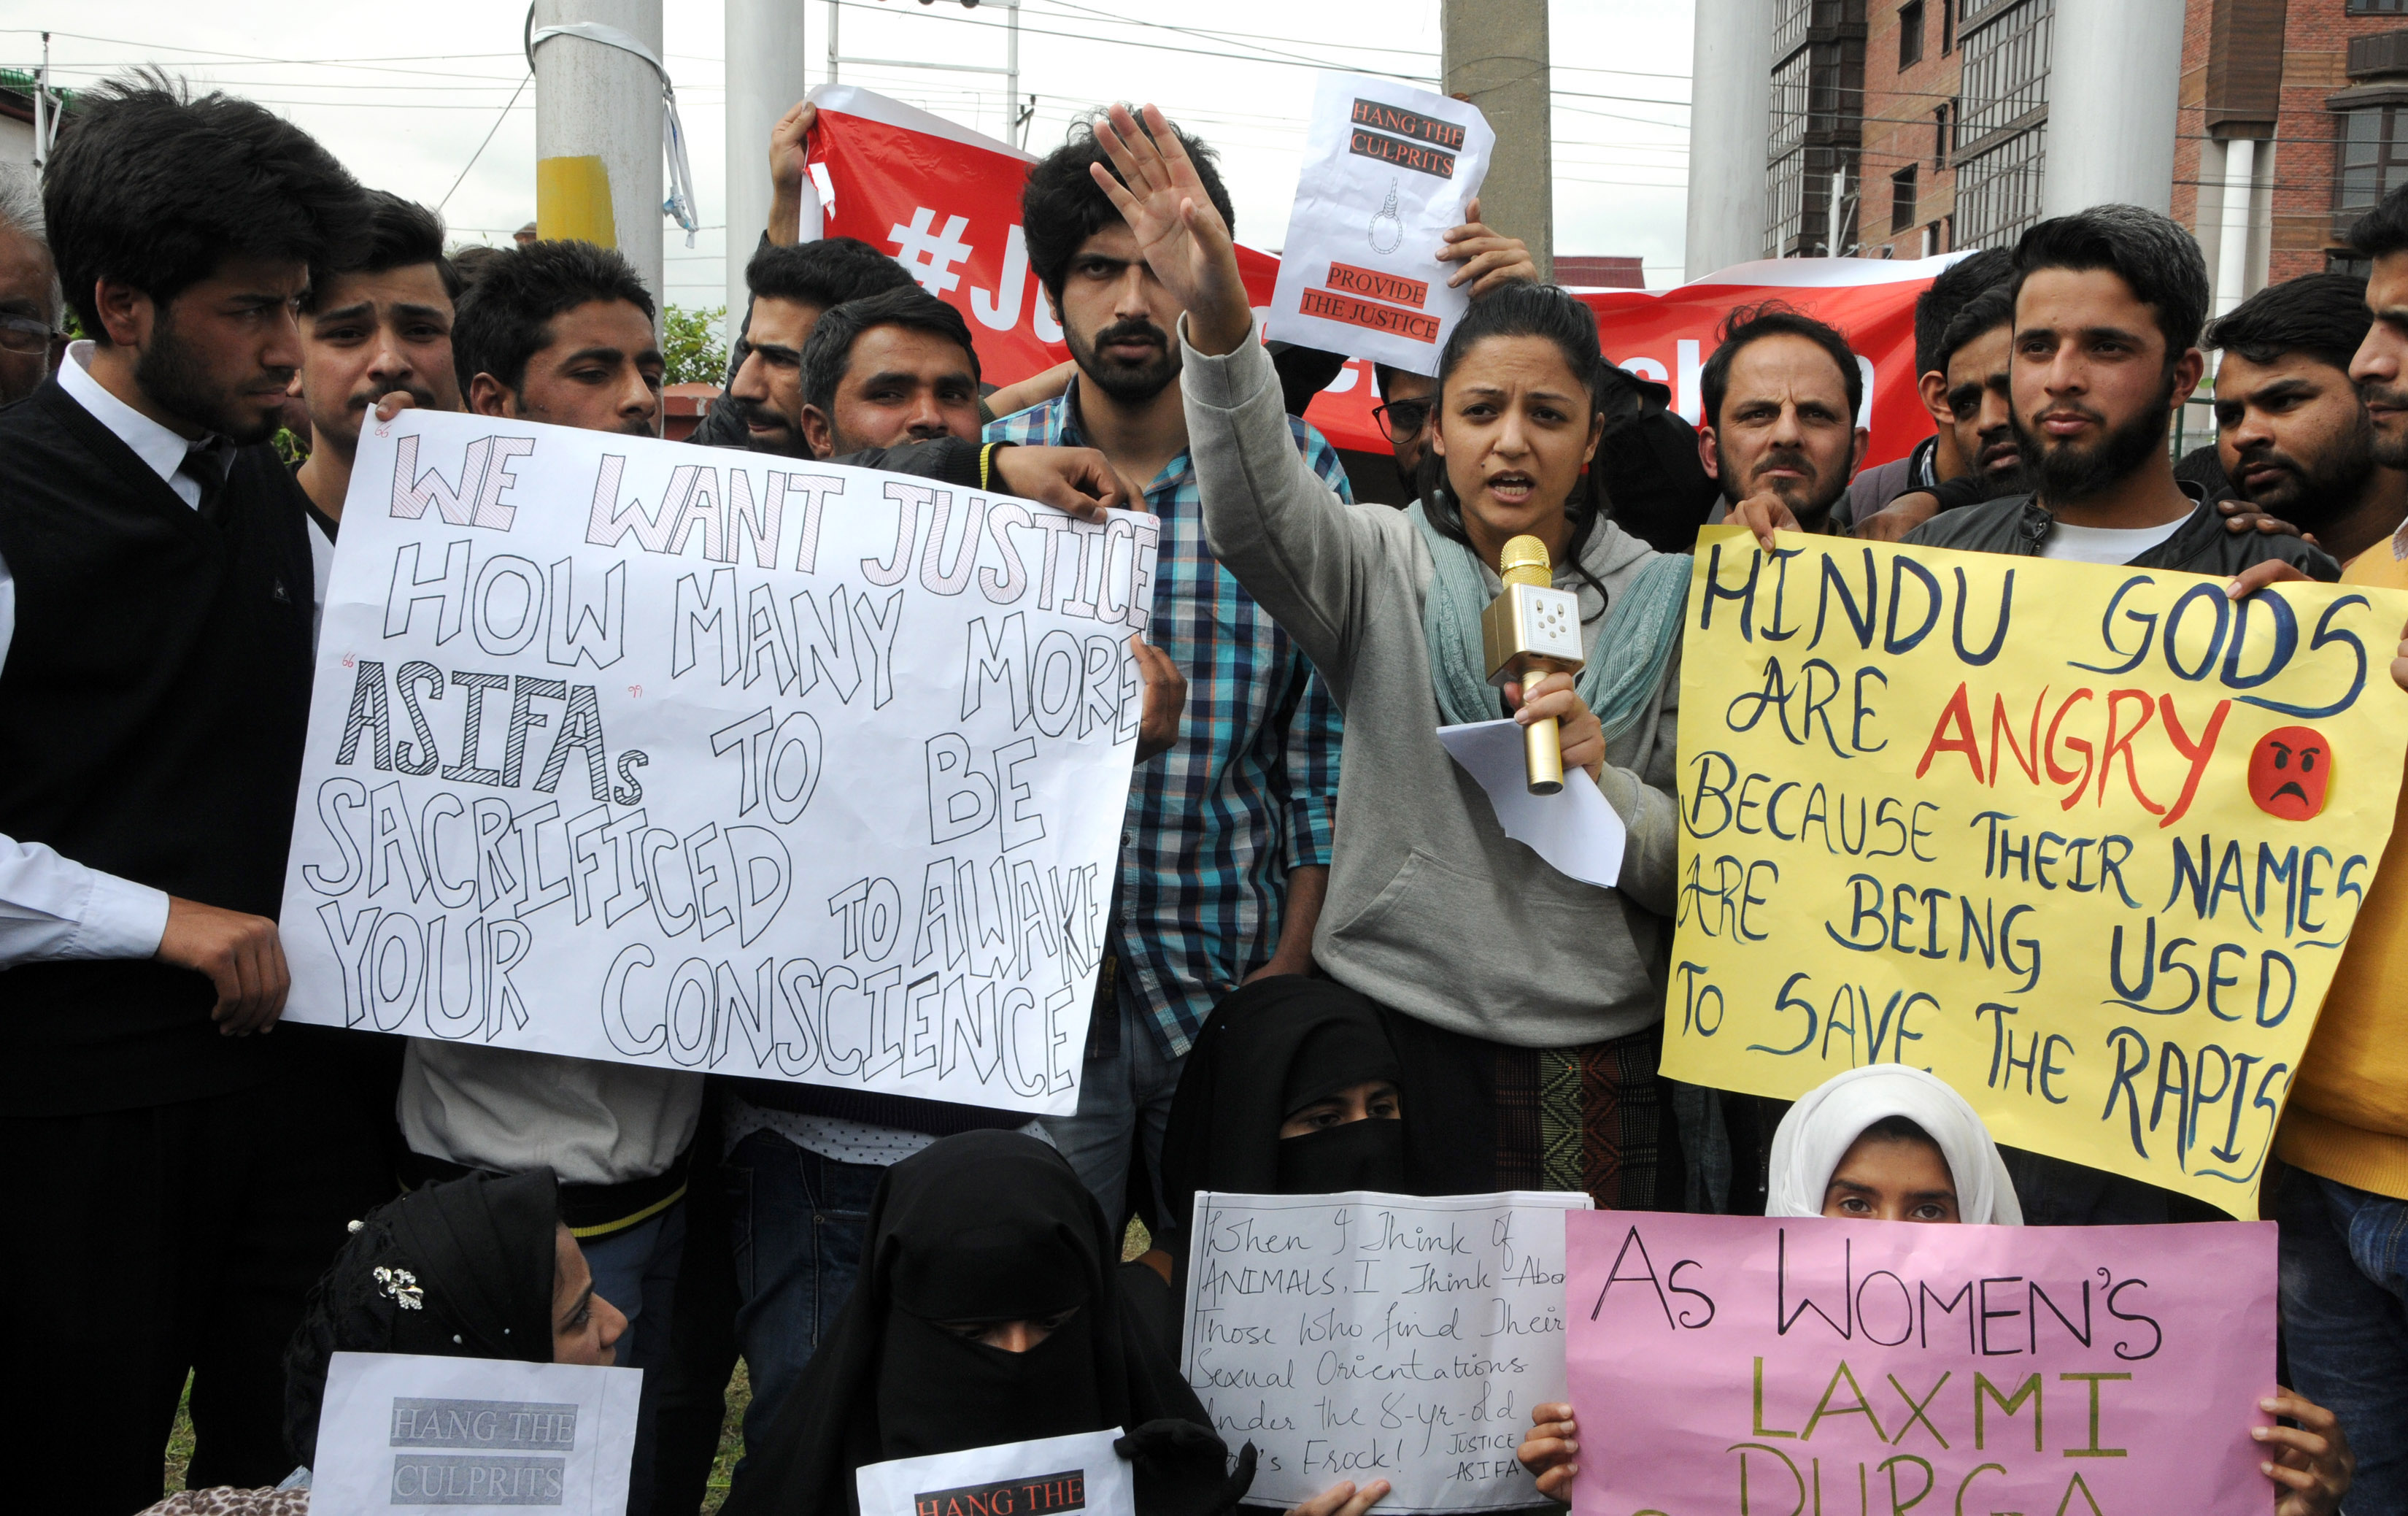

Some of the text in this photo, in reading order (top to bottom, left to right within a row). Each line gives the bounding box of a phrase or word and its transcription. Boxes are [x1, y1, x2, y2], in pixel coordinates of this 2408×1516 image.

[1351, 132, 1454, 177] CULPRITS
[1352, 101, 1465, 147] HANG THE
[1303, 291, 1440, 340] THE JUSTICE
[1328, 266, 1427, 305] PROVIDE
[584, 453, 846, 575] WANT
[383, 539, 1143, 746] HOW MANY MORE
[1699, 543, 2372, 720] HINDU GODS
[710, 706, 822, 825] TO
[925, 732, 1046, 853] BE
[1725, 655, 2233, 830] ARE ANGRY
[303, 777, 1102, 985] SACRIFICED TO AWAKE
[1680, 750, 2368, 950] BECAUSE THEIR NAMES
[1678, 853, 2297, 1029] ARE BEING USED
[316, 900, 1075, 1098] YOUR CONSCIENCE
[1676, 960, 1724, 1038] TO
[1745, 971, 1942, 1076] SAVE
[1975, 1001, 2075, 1104] THE
[1352, 1260, 1381, 1293] I
[1189, 1347, 1529, 1389] Sexual Orientations
[390, 1407, 575, 1444] HANG THE
[1446, 1431, 1516, 1456] JUSTICE
[1752, 1355, 2132, 1458] LAXMI
[393, 1463, 564, 1499] CULPRITS
[1021, 1476, 1084, 1512] THE
[1446, 1458, 1520, 1482] ASIFA
